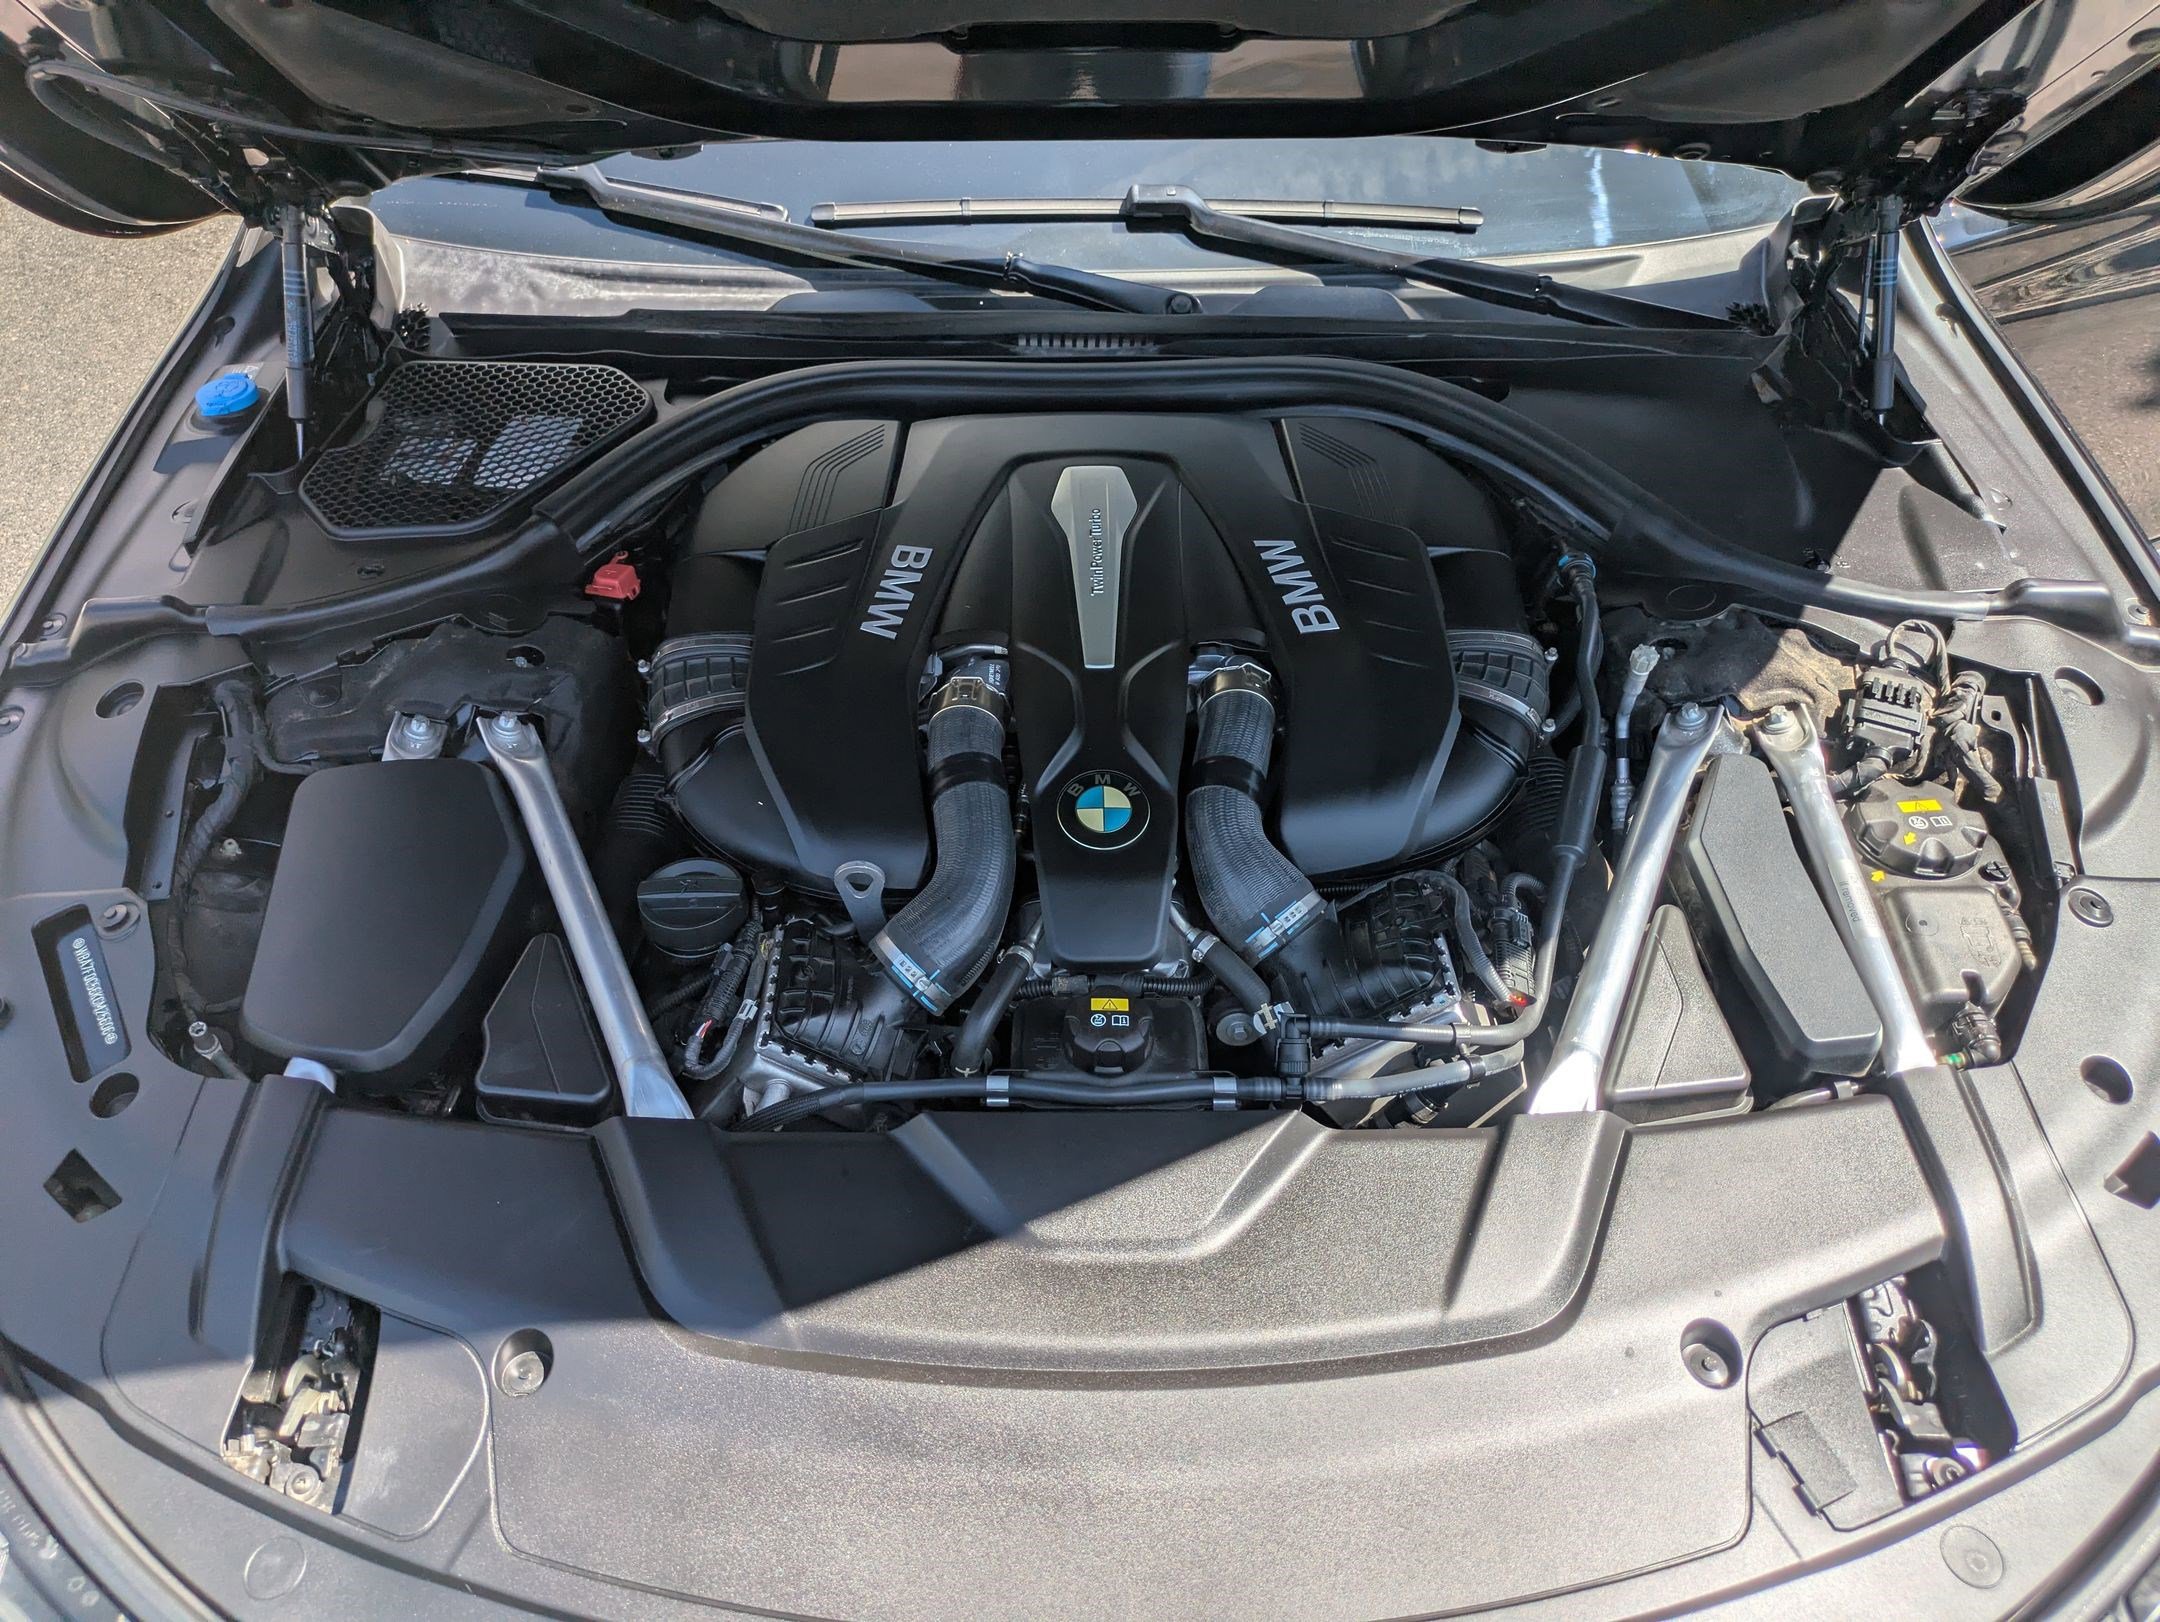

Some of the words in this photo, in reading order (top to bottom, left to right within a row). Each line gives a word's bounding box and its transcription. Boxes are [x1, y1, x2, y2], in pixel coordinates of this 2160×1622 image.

[1089, 508, 1103, 537] Turbo
[1090, 537, 1104, 597] TwinPower
[1254, 540, 1340, 634] BMW
[860, 545, 933, 640] BMW
[1067, 774, 1141, 797] BMW
[1843, 886, 1862, 922] removed
